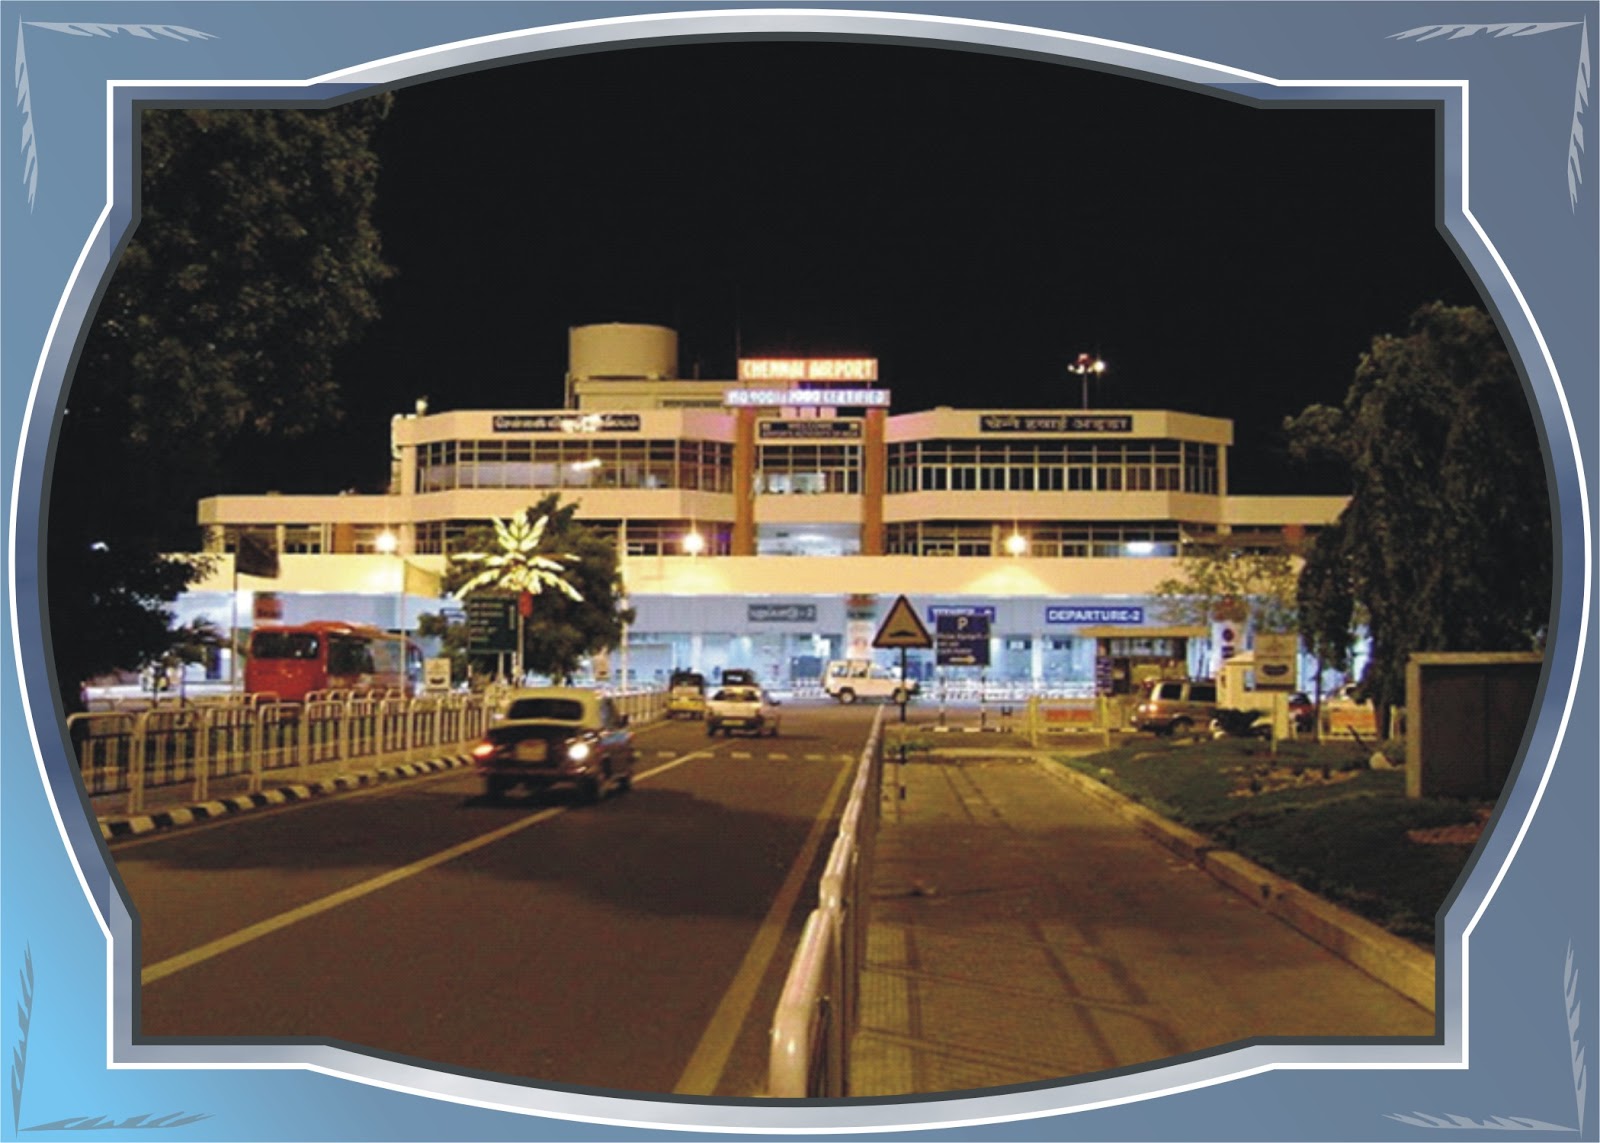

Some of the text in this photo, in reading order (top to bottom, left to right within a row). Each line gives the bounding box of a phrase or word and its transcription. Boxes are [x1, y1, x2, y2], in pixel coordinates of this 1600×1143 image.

[744, 359, 873, 378] CHENNAI AIRPORT
[1048, 609, 1140, 621] DEPARTURE-2
[957, 616, 969, 631] P
